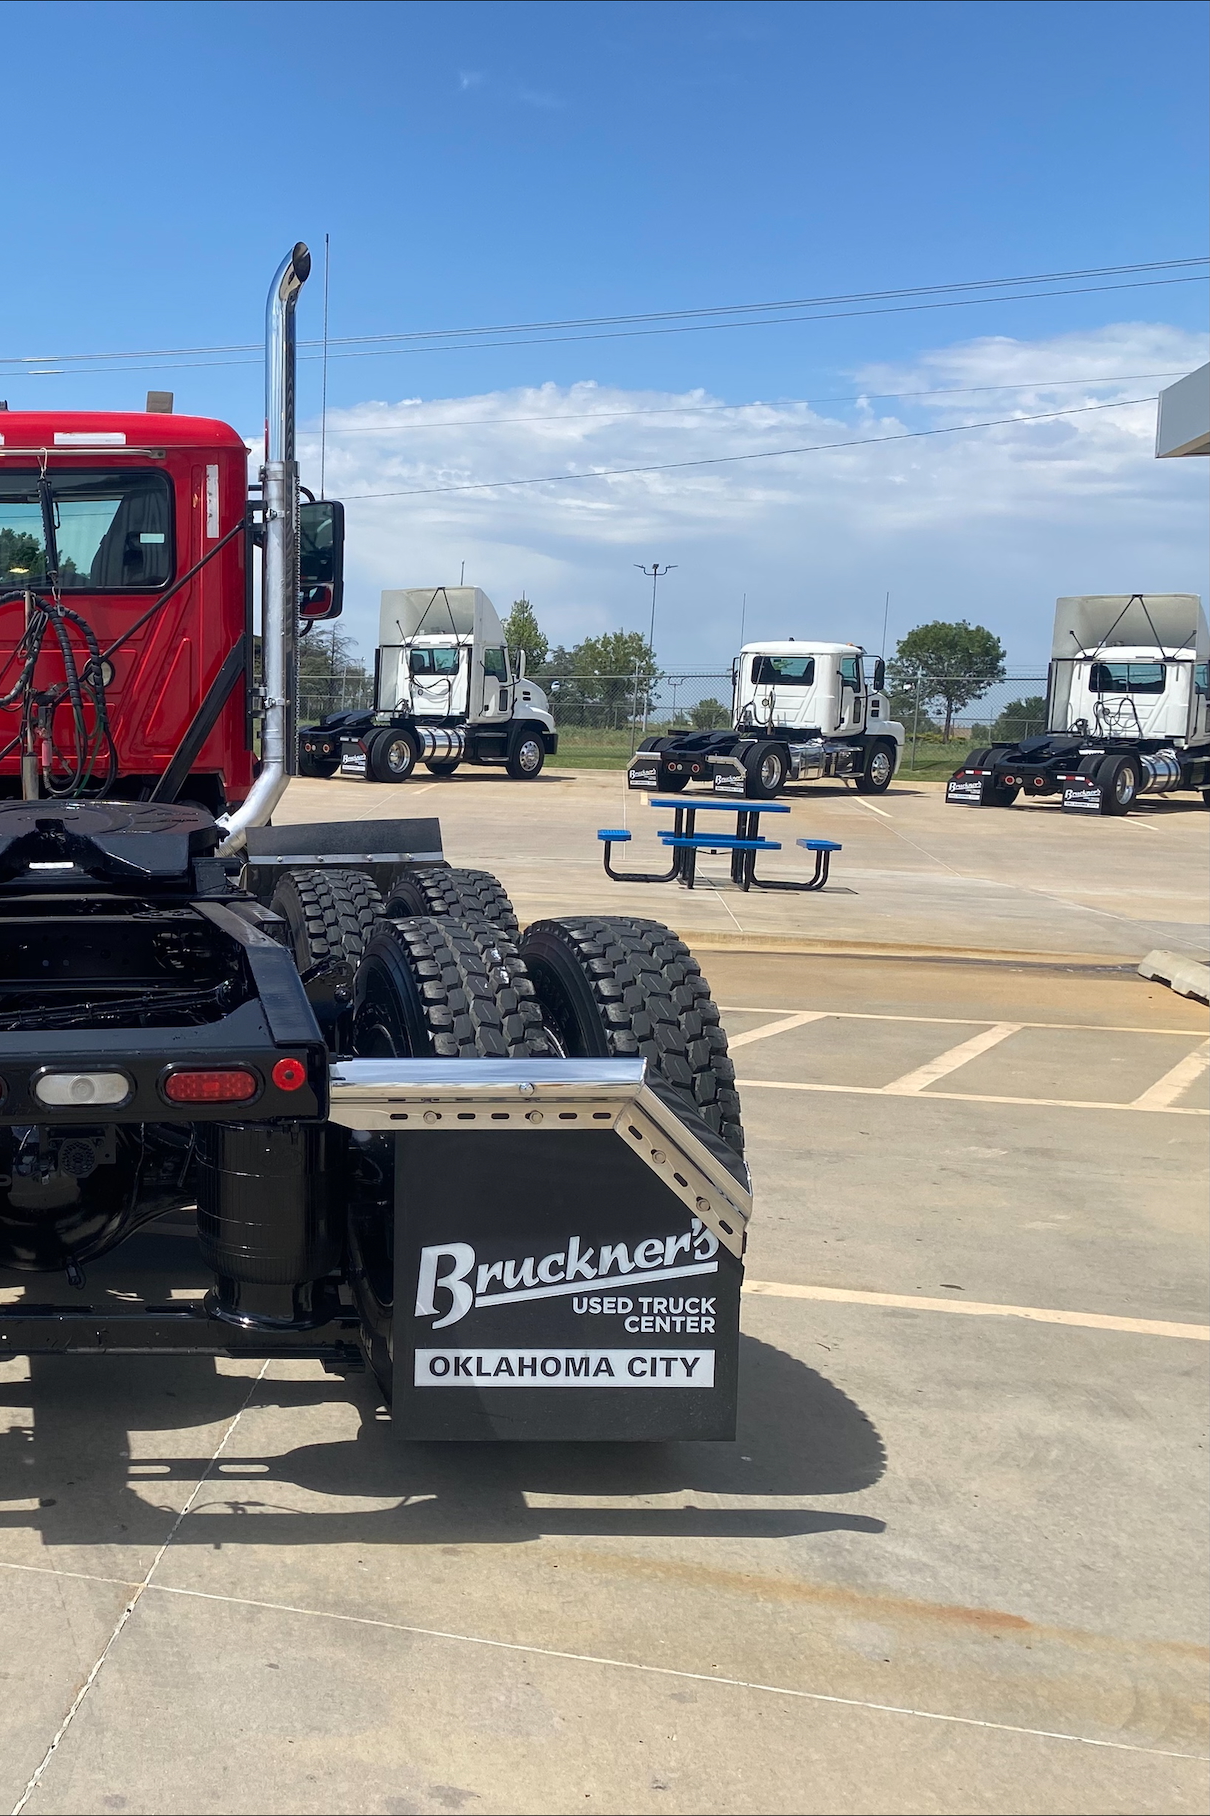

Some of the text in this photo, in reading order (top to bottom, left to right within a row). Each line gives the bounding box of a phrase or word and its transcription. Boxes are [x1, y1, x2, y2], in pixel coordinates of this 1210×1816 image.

[414, 1217, 720, 1330] Bruckner's
[572, 1296, 717, 1315] USED TRUCK
[623, 1315, 716, 1334] CENTER
[428, 1356, 701, 1377] OKLAHOMA CITY
